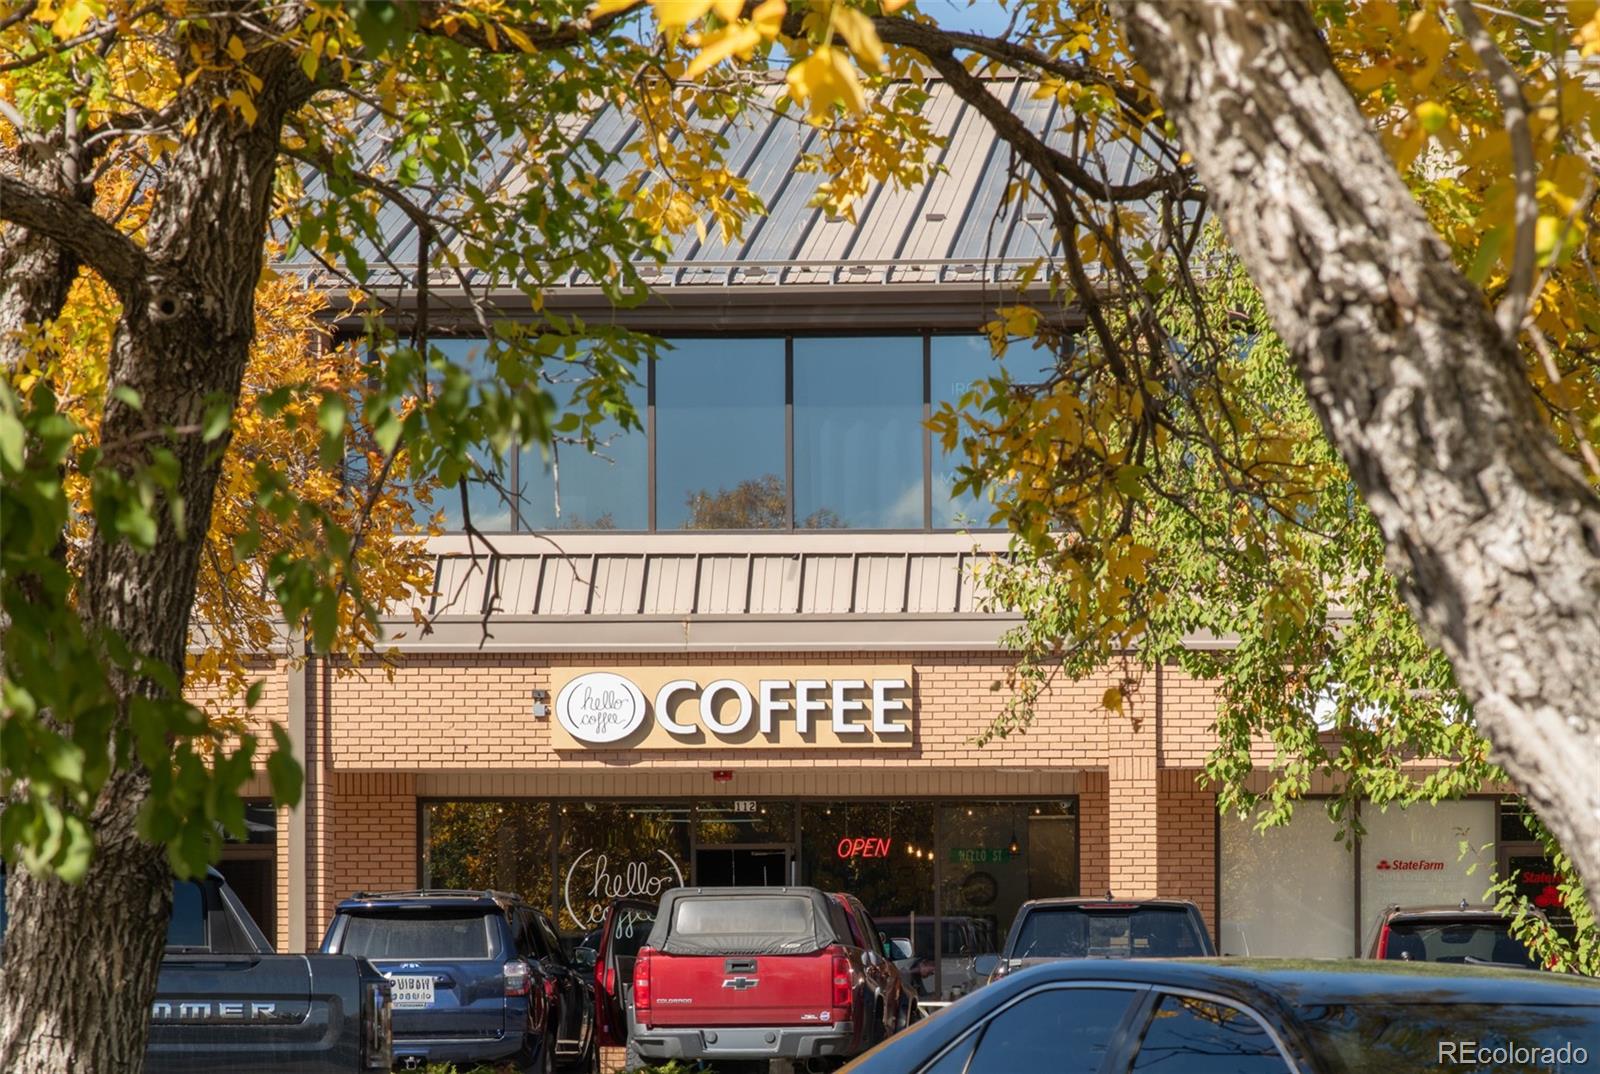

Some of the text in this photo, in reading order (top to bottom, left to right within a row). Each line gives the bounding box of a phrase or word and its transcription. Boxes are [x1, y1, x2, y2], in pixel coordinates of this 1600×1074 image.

[580, 686, 629, 711] hello
[655, 679, 906, 734] COFFEE
[580, 712, 626, 734] coffee
[735, 801, 756, 812] 112
[837, 837, 891, 858] OPEN
[588, 854, 672, 898] hello
